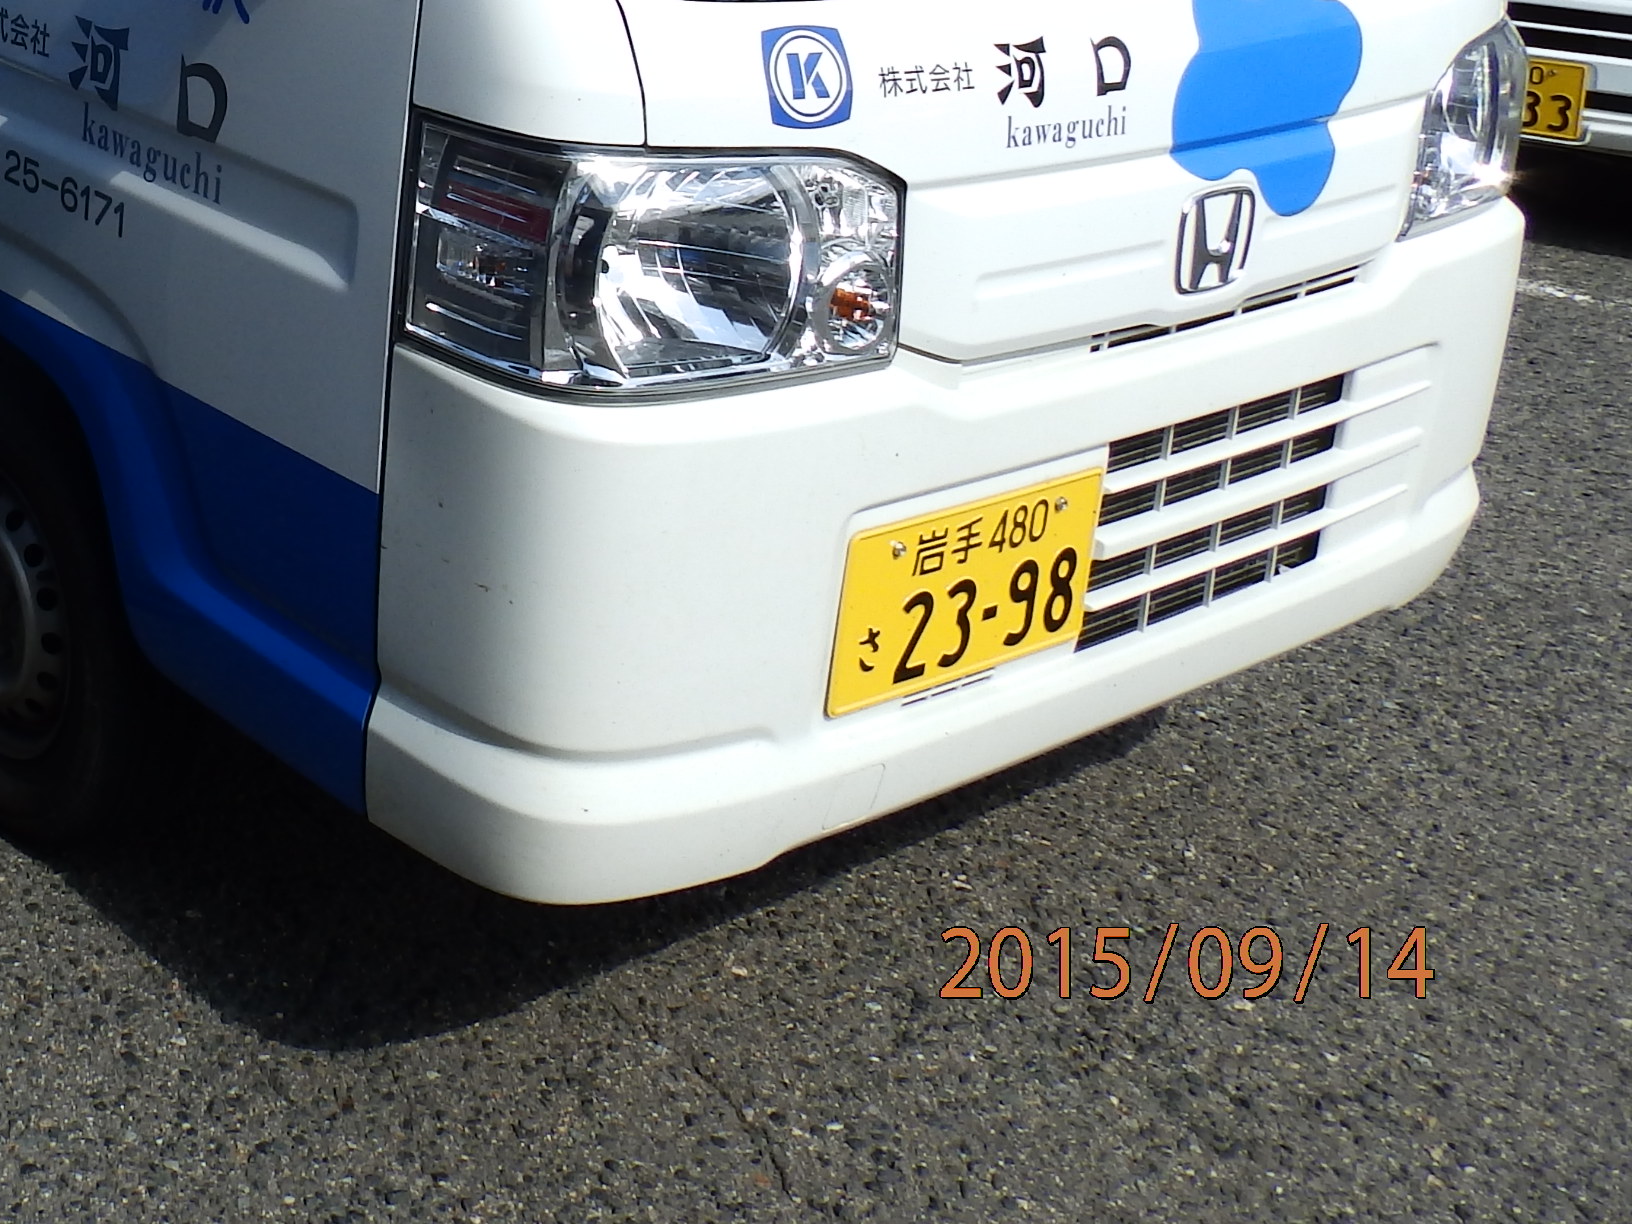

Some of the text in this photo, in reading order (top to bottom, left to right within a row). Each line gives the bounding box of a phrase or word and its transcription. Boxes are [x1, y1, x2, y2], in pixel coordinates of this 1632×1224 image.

[878, 62, 976, 98] 株式会社
[81, 101, 222, 204] kawaguchi
[1006, 105, 1128, 149] kawaguchi
[4, 150, 125, 238] 25-6171
